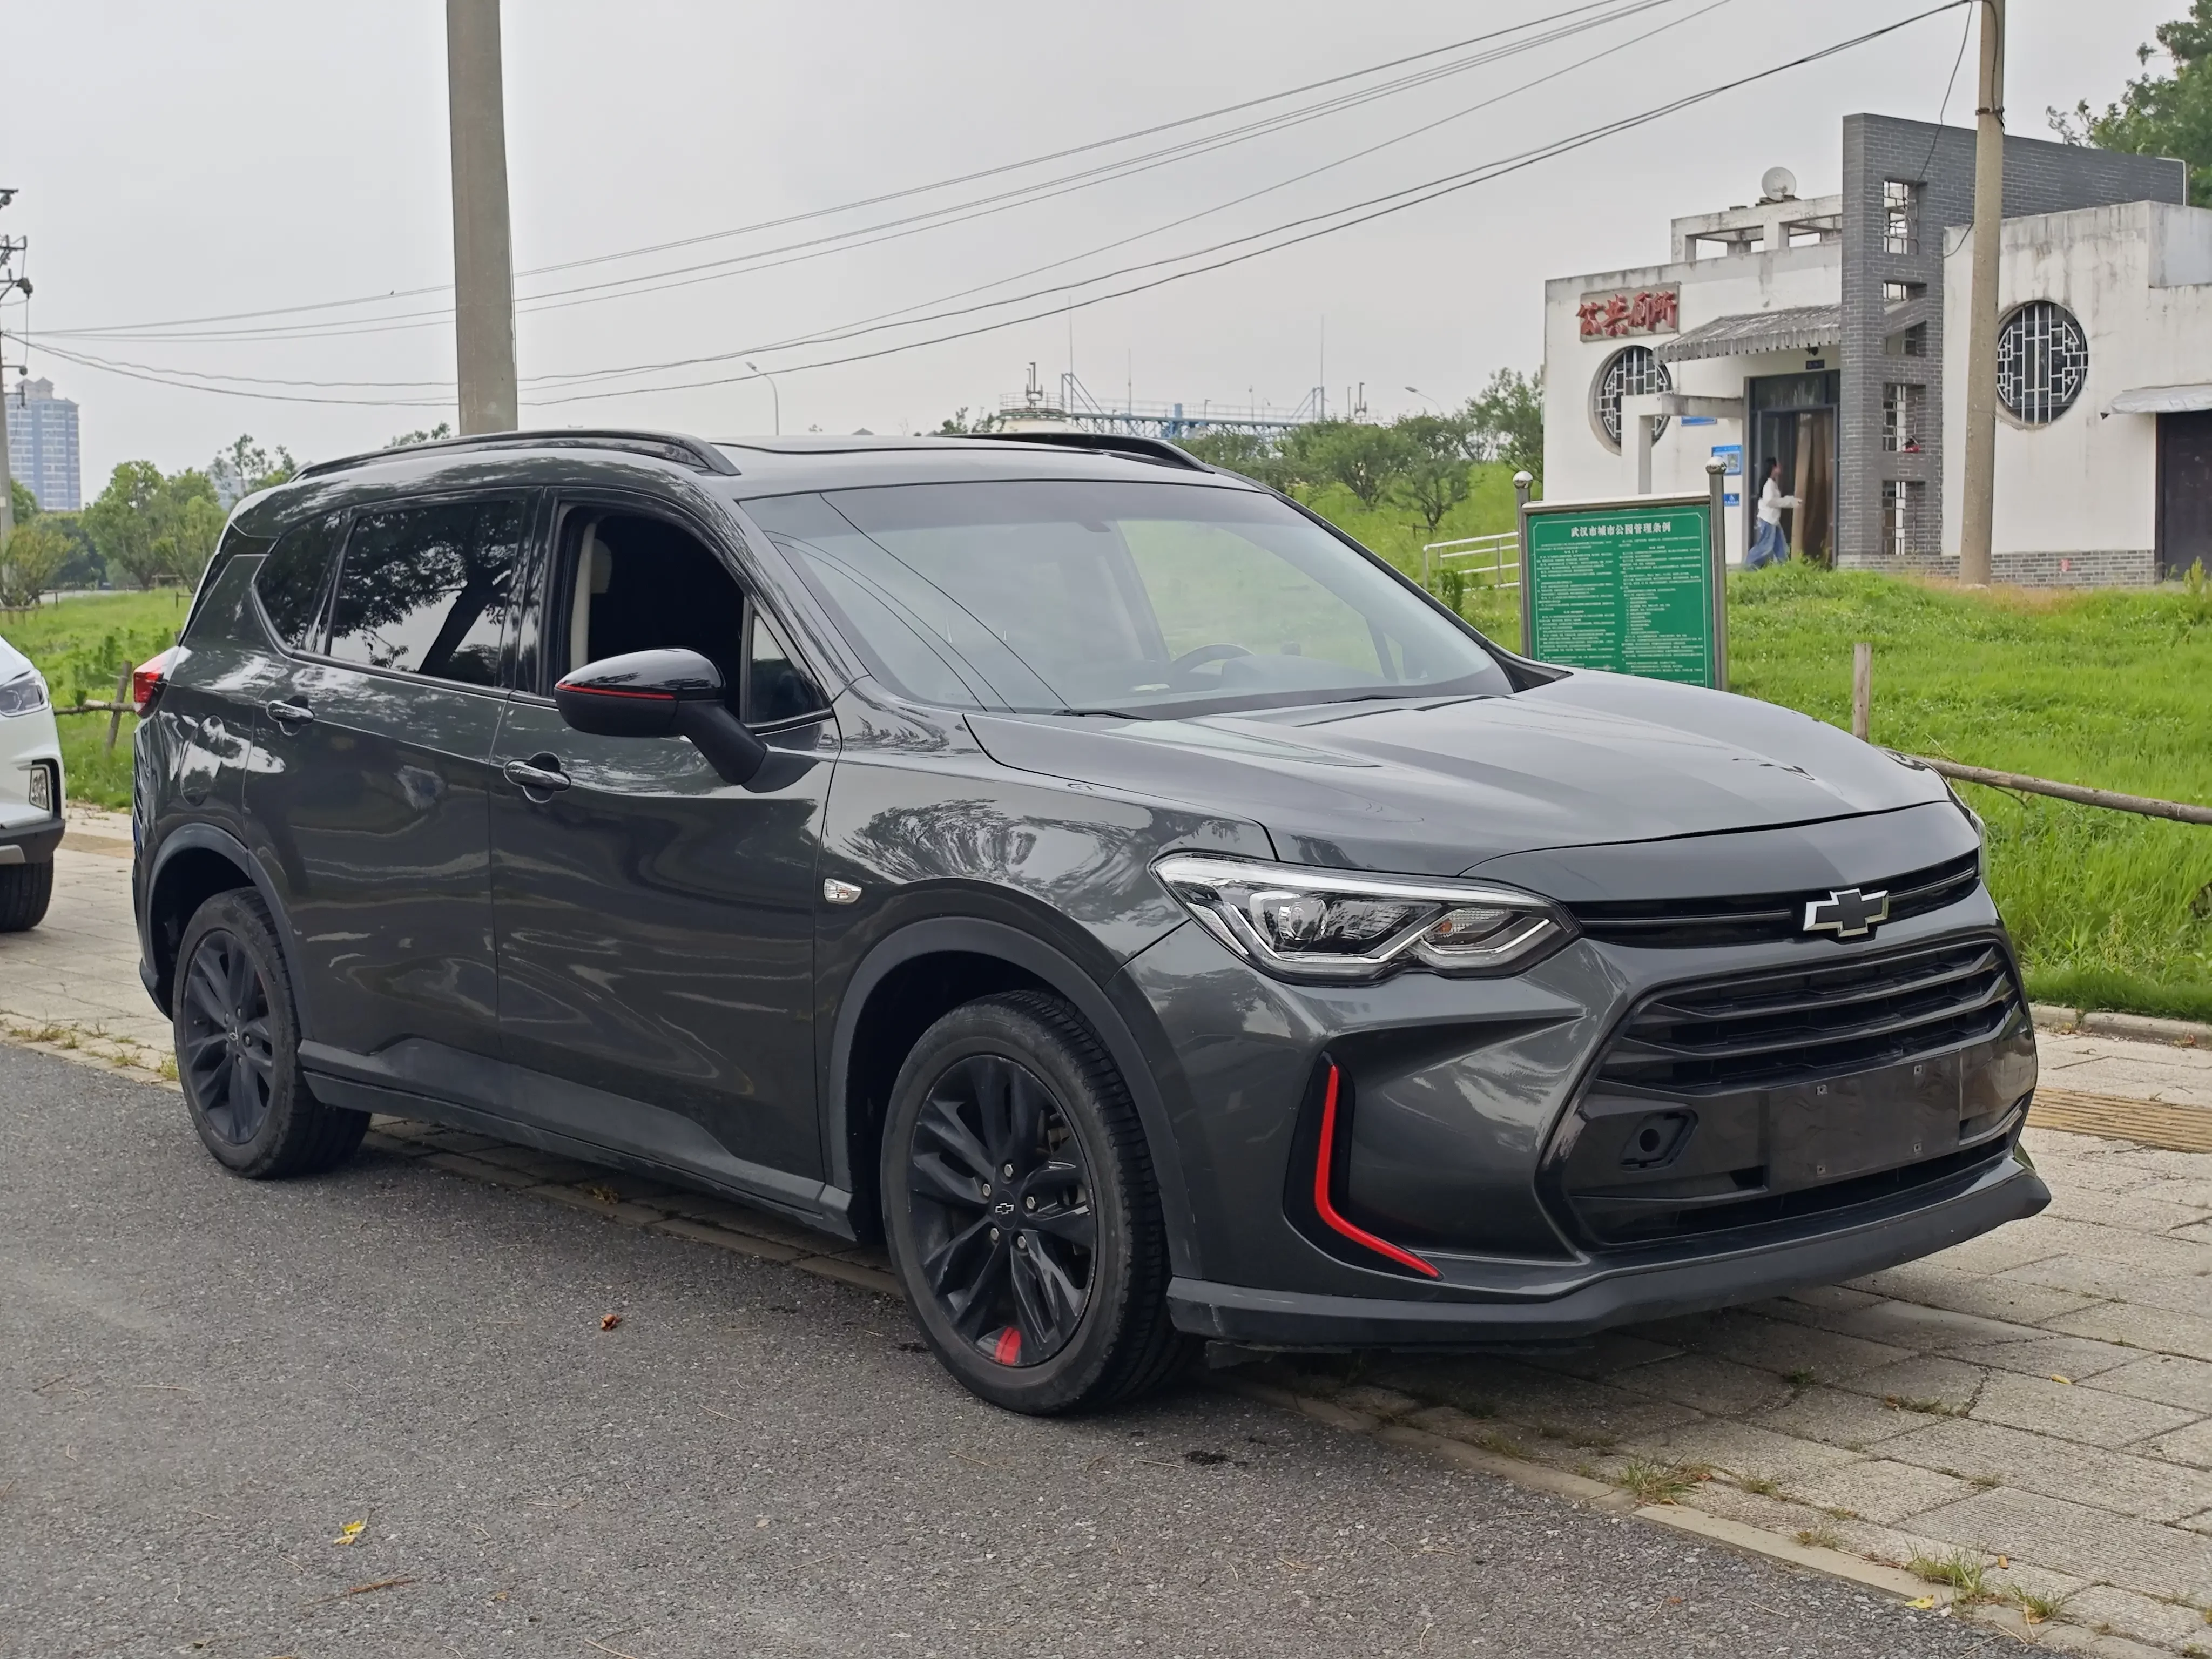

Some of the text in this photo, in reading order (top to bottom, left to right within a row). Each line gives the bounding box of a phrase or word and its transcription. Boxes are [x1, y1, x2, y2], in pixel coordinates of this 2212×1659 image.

[1576, 291, 1677, 337] 公共厕所
[1571, 522, 1671, 537] 武汉市城市公园管理条例
